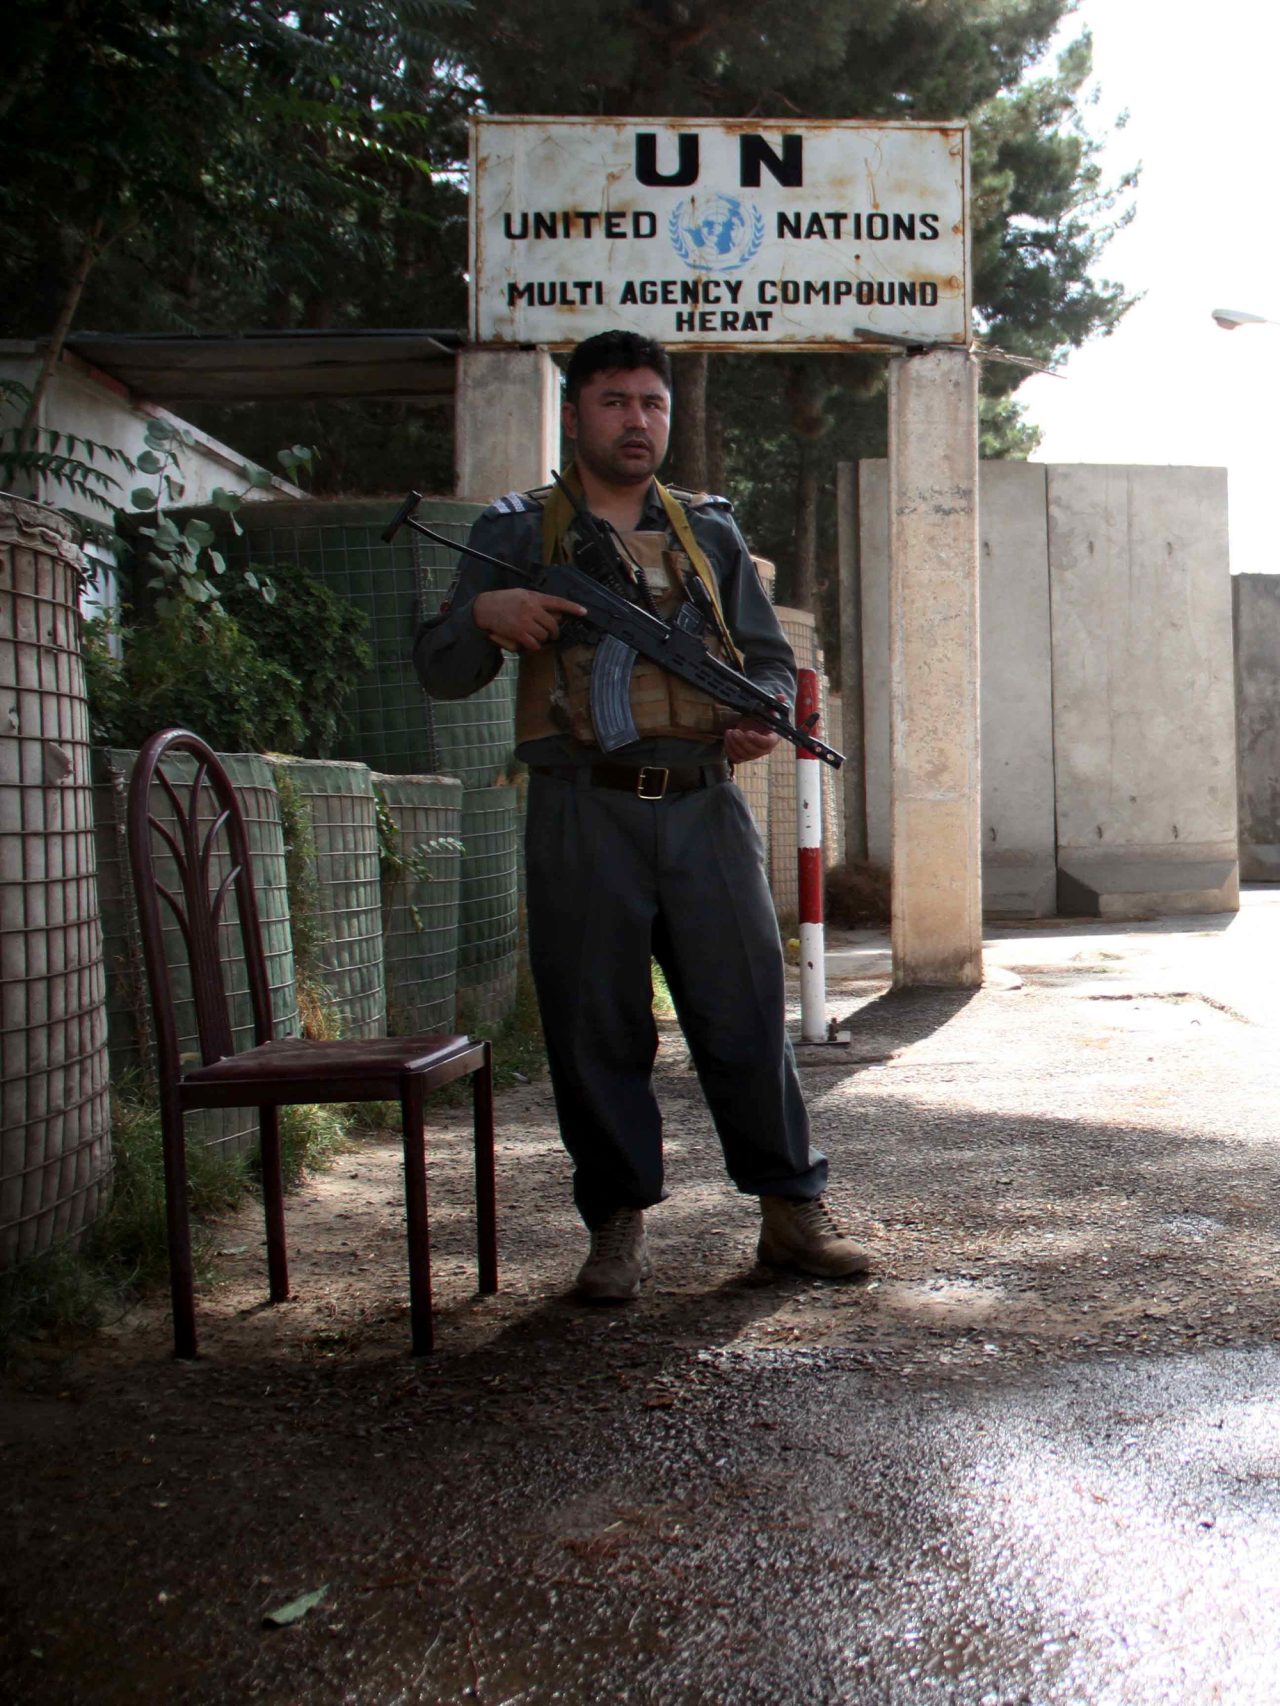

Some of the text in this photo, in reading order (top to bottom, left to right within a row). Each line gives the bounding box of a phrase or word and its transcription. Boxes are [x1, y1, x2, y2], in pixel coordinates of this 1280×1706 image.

[503, 209, 940, 242] UNITED NATIONS
[506, 279, 938, 309] MULTI AGENCY COMPOUND
[675, 310, 773, 332] HERAT
